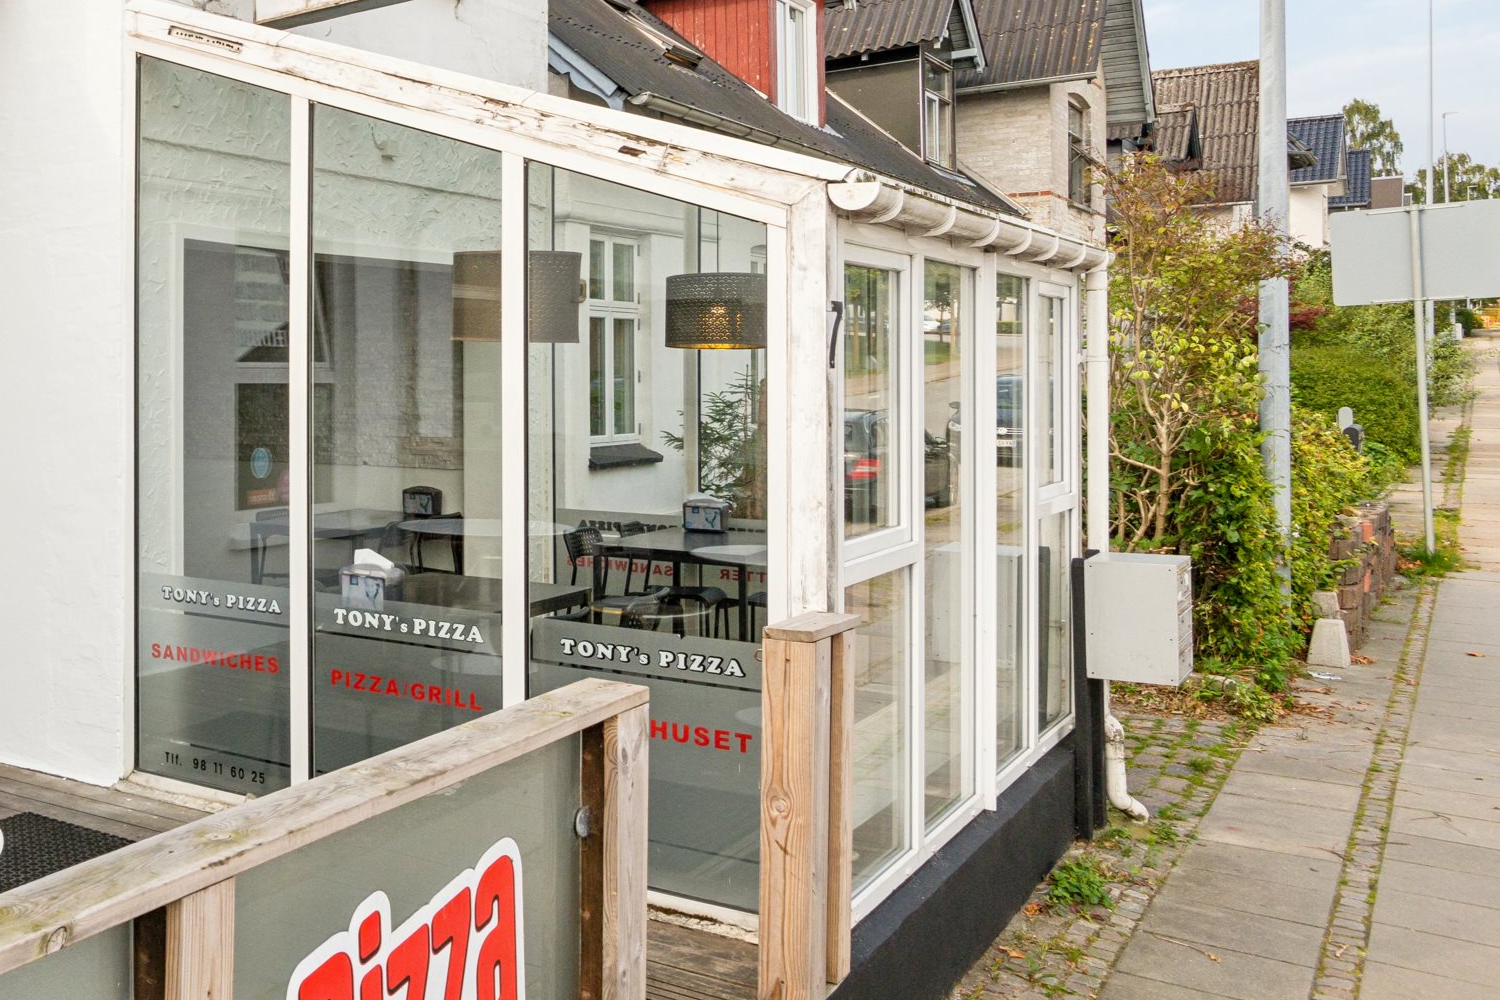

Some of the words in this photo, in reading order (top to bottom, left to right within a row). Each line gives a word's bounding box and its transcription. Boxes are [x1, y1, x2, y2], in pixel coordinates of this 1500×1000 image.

[161, 586, 220, 606] TONY's
[226, 594, 282, 614] PIZZA
[333, 607, 408, 633] TONY's
[411, 619, 485, 644] PIZZA
[151, 643, 280, 674] SANDWICHES
[559, 638, 650, 665] TONY's
[658, 650, 746, 677] PIZZA
[330, 669, 483, 712] PIZZA/GRILL
[650, 719, 752, 753] HUSET
[193, 758, 207, 771] 98
[213, 762, 223, 775] 11
[231, 765, 245, 779] 60
[251, 771, 265, 784] 25
